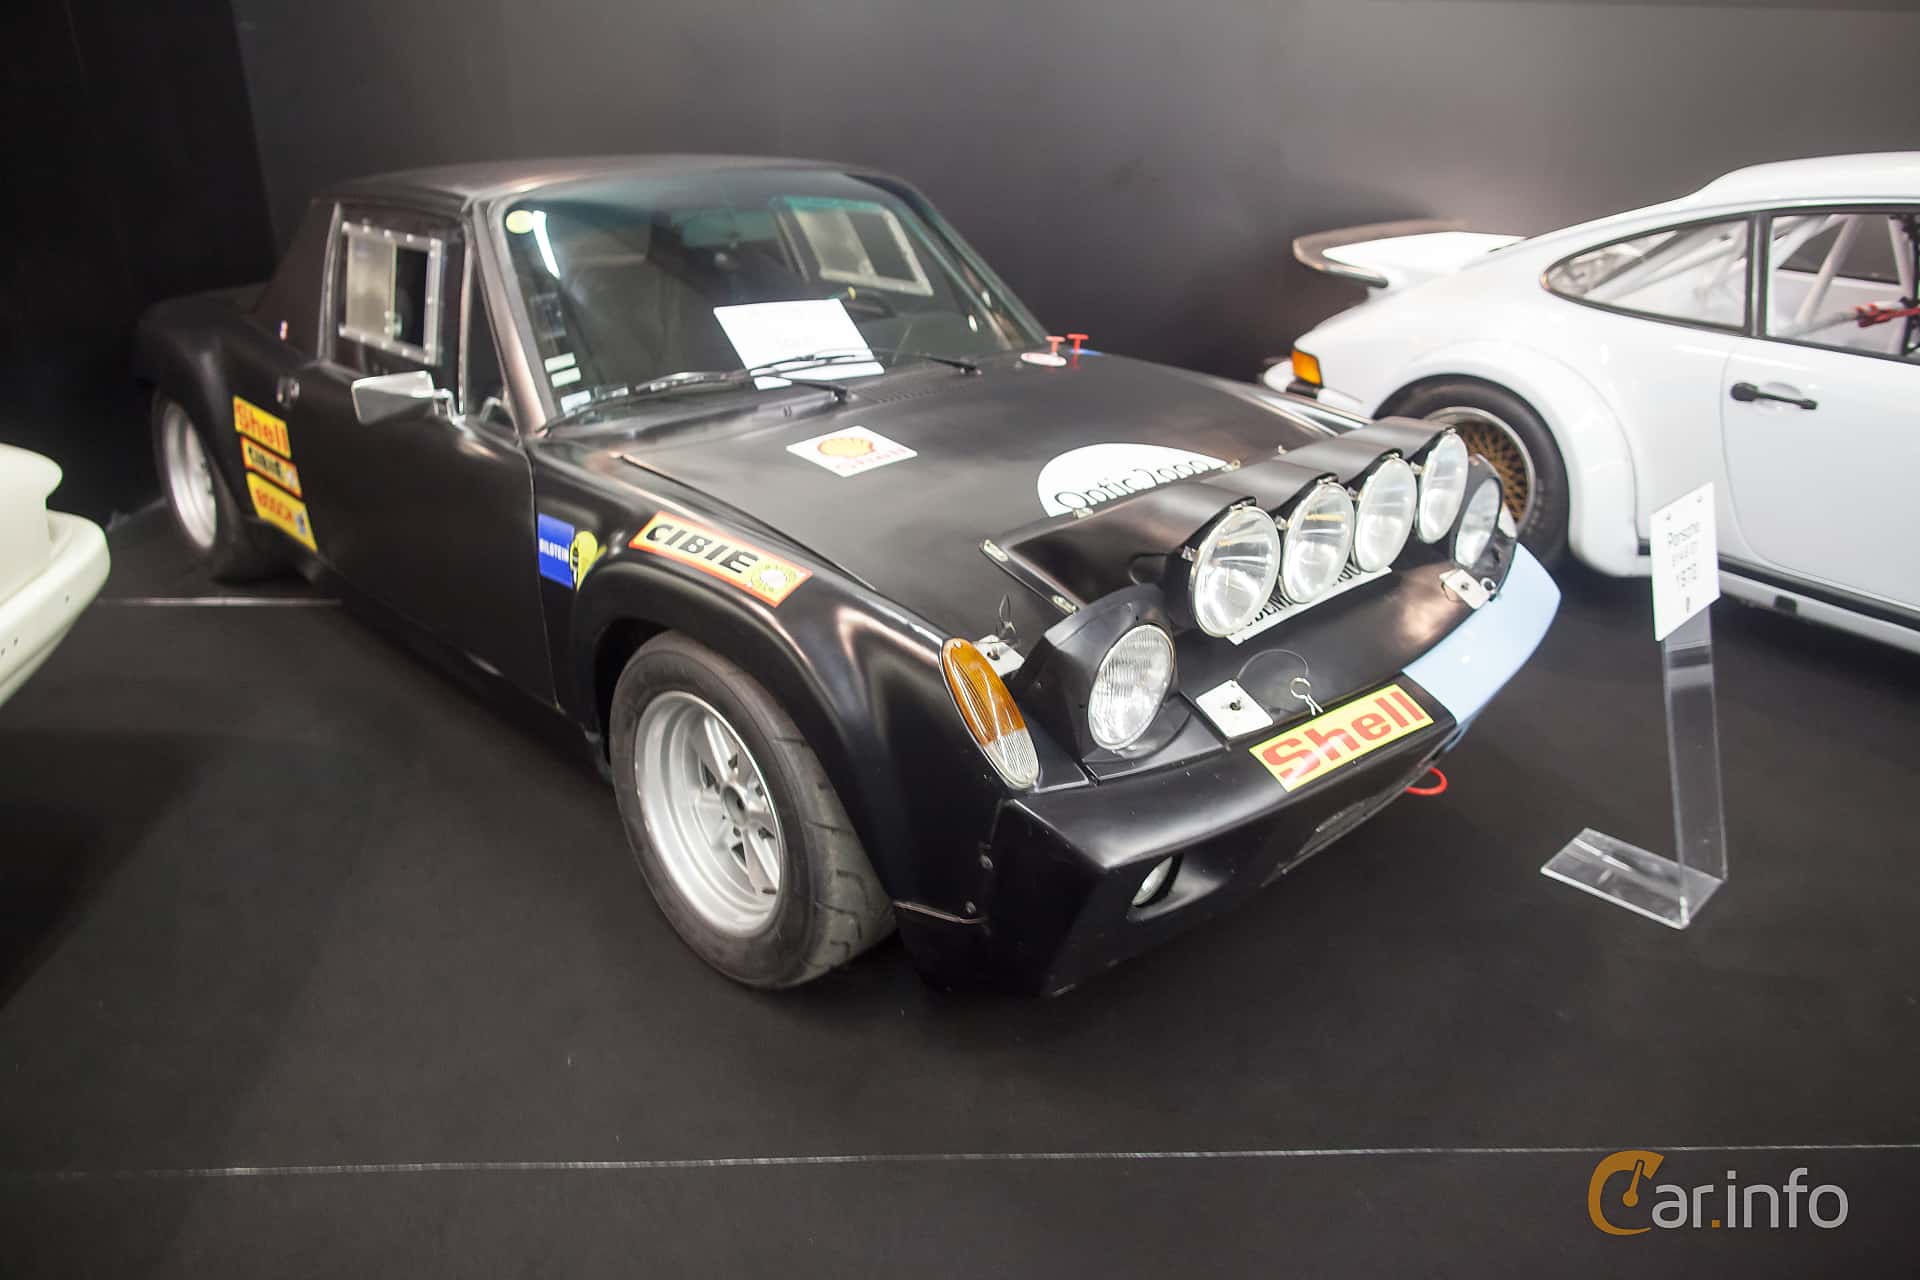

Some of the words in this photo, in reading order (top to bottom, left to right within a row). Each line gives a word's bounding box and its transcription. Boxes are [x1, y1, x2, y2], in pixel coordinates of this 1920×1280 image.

[235, 403, 288, 455] Shell
[538, 537, 570, 563] BILSTEIN
[646, 523, 759, 574] CIBIE
[1262, 691, 1425, 780] Shell
